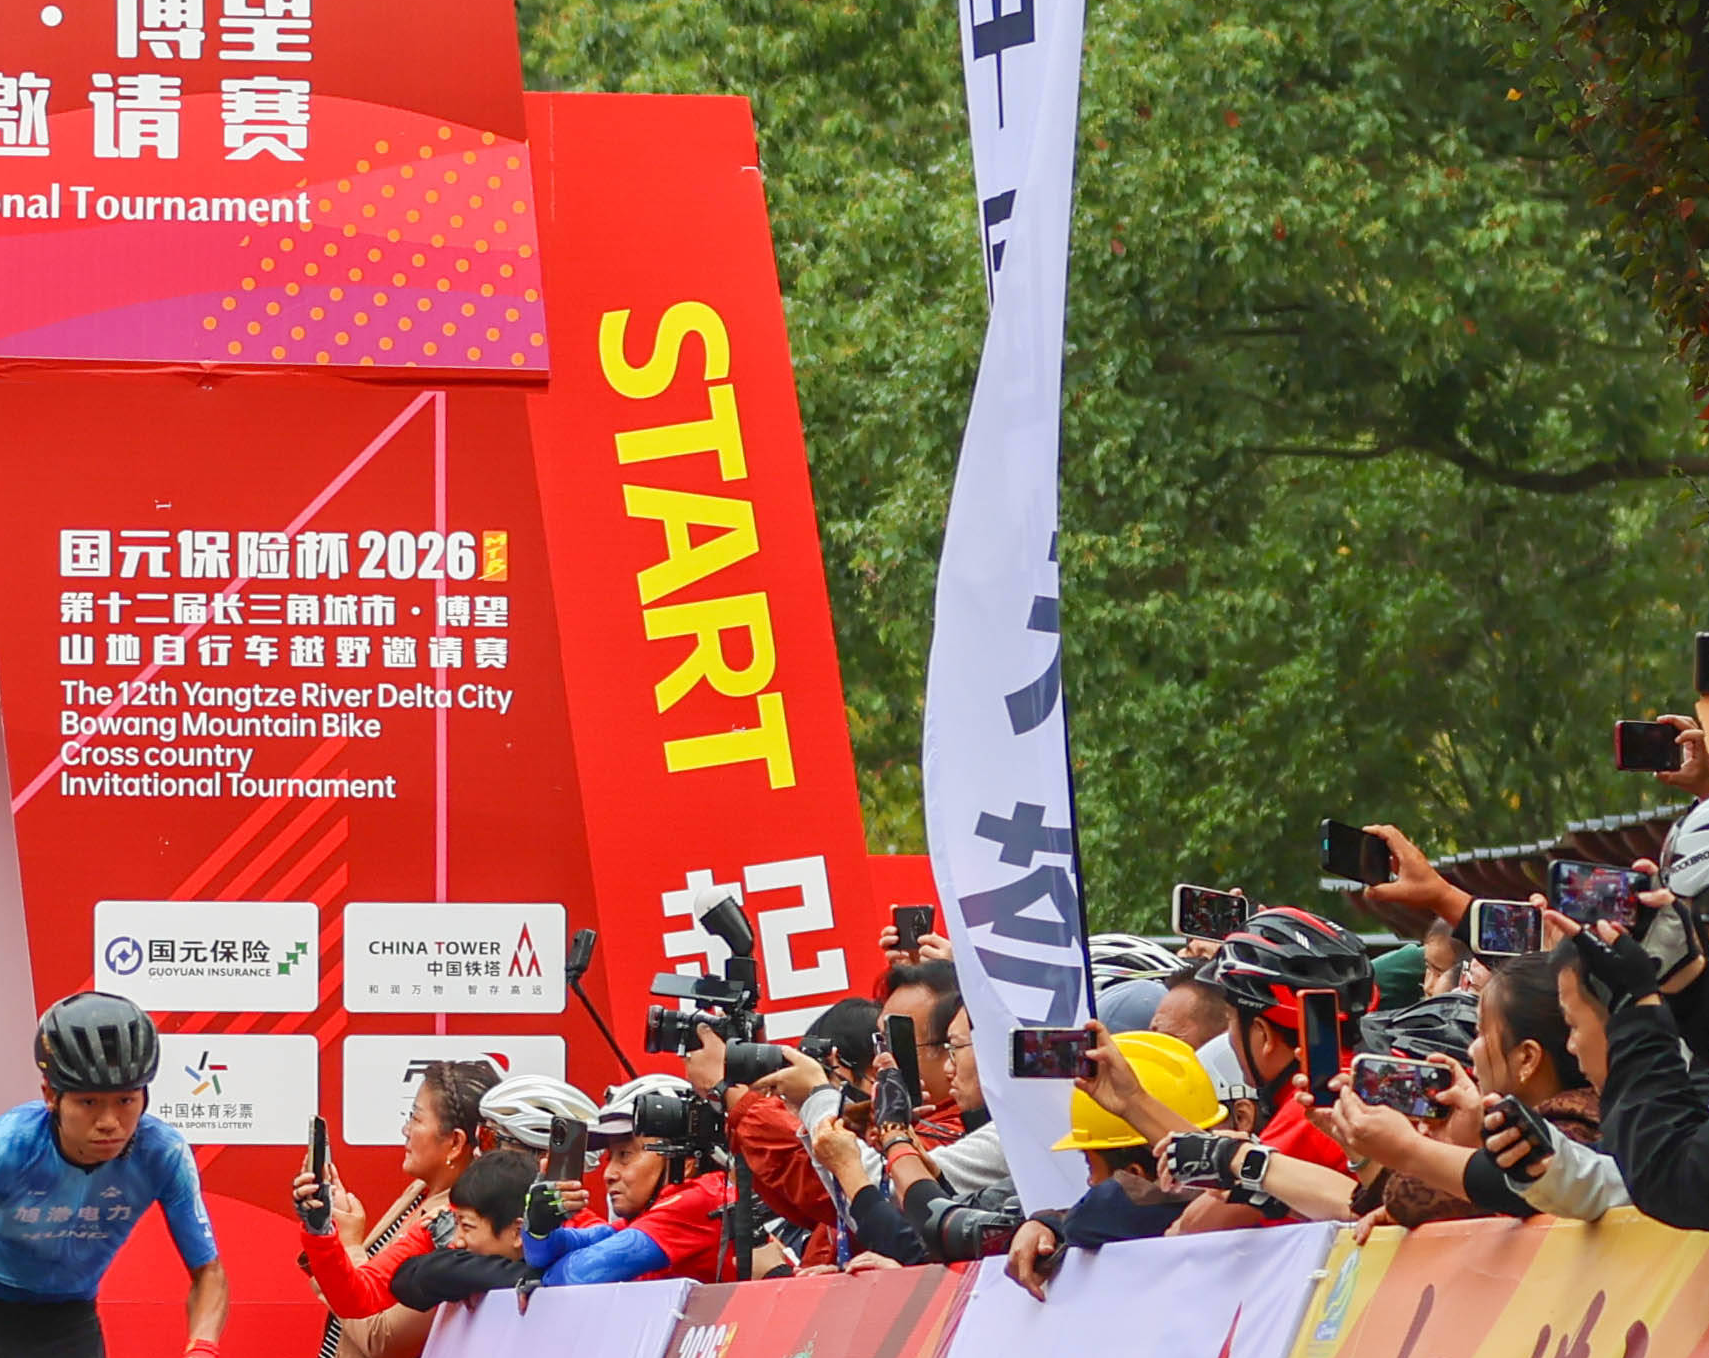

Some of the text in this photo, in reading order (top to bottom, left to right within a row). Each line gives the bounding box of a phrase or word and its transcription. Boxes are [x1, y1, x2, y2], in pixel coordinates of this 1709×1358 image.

[69, 186, 311, 225] Tournament
[60, 529, 349, 580] 国元保险杯
[358, 530, 476, 580] 2026
[598, 300, 797, 789] START
[60, 634, 508, 670] 山地自行车越野邀请赛
[60, 679, 513, 714] The 12th Yangtze River Delta City
[60, 711, 381, 739] Bowang Mountain Bike
[60, 741, 253, 773] Cross country
[61, 771, 396, 799] Invitational Tournament
[147, 939, 271, 964] 国元保险
[368, 941, 501, 955] CHINA TOWER
[147, 967, 272, 978] GUOYUAN INSURANCE
[427, 960, 501, 978] 中国铁塔
[159, 1102, 254, 1119] 中国体育彩票
[187, 1121, 219, 1129] SPORTS
[221, 1121, 253, 1129] LOTTERY
